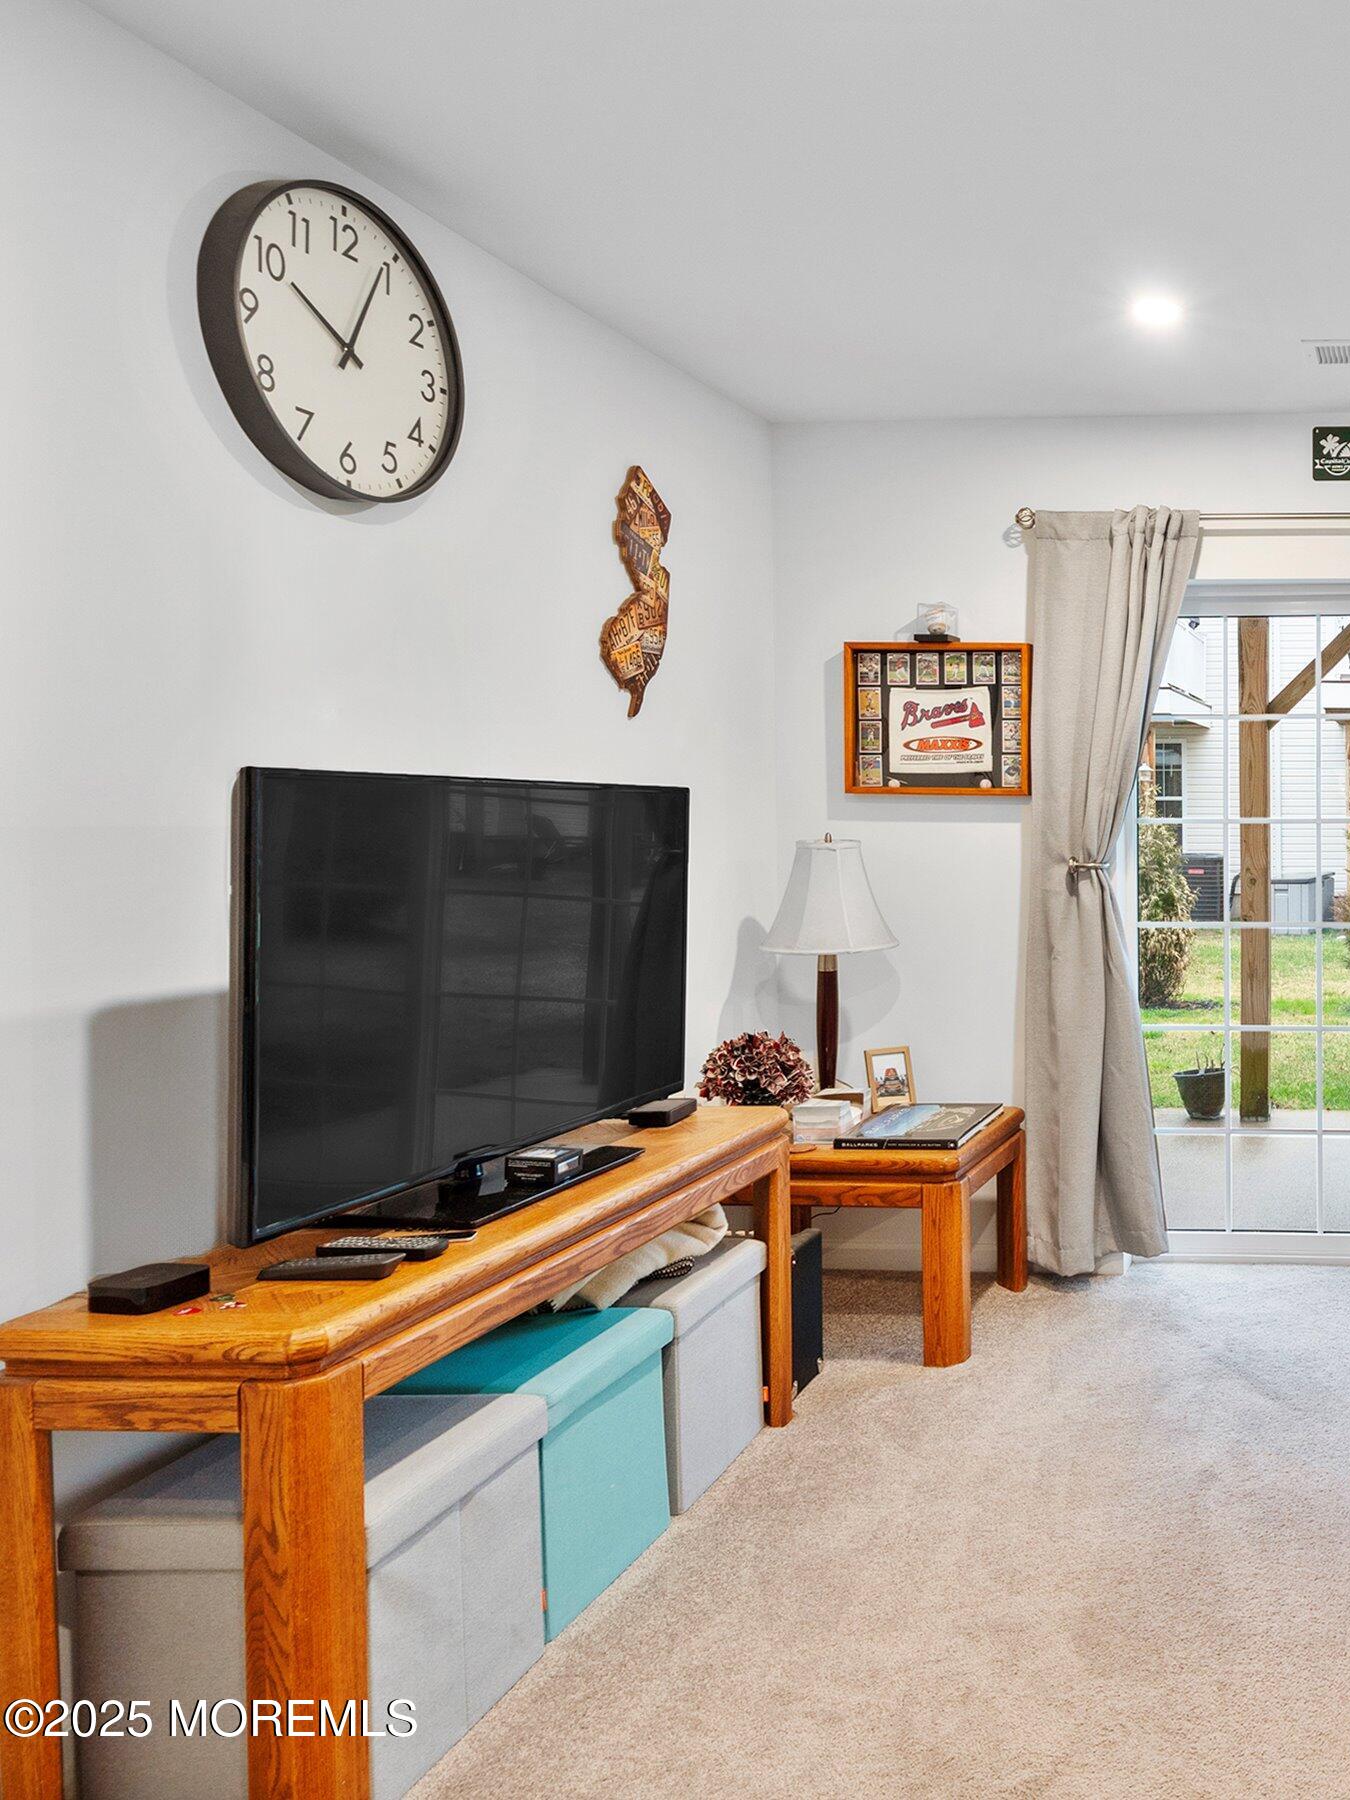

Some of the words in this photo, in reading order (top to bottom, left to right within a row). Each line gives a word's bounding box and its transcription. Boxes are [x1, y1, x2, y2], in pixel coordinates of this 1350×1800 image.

[288, 210, 310, 254] 11
[330, 215, 358, 262] 12
[252, 234, 286, 282] 10
[382, 261, 391, 296] 1
[239, 287, 259, 324] 9
[408, 313, 424, 349] 2
[257, 354, 276, 392] 8
[420, 369, 436, 403] 3
[295, 406, 315, 441] 7
[407, 417, 424, 448] 4
[339, 441, 357, 475] 6
[381, 441, 397, 474] 5
[901, 698, 968, 731] Braves
[916, 738, 970, 752] MAXXIS
